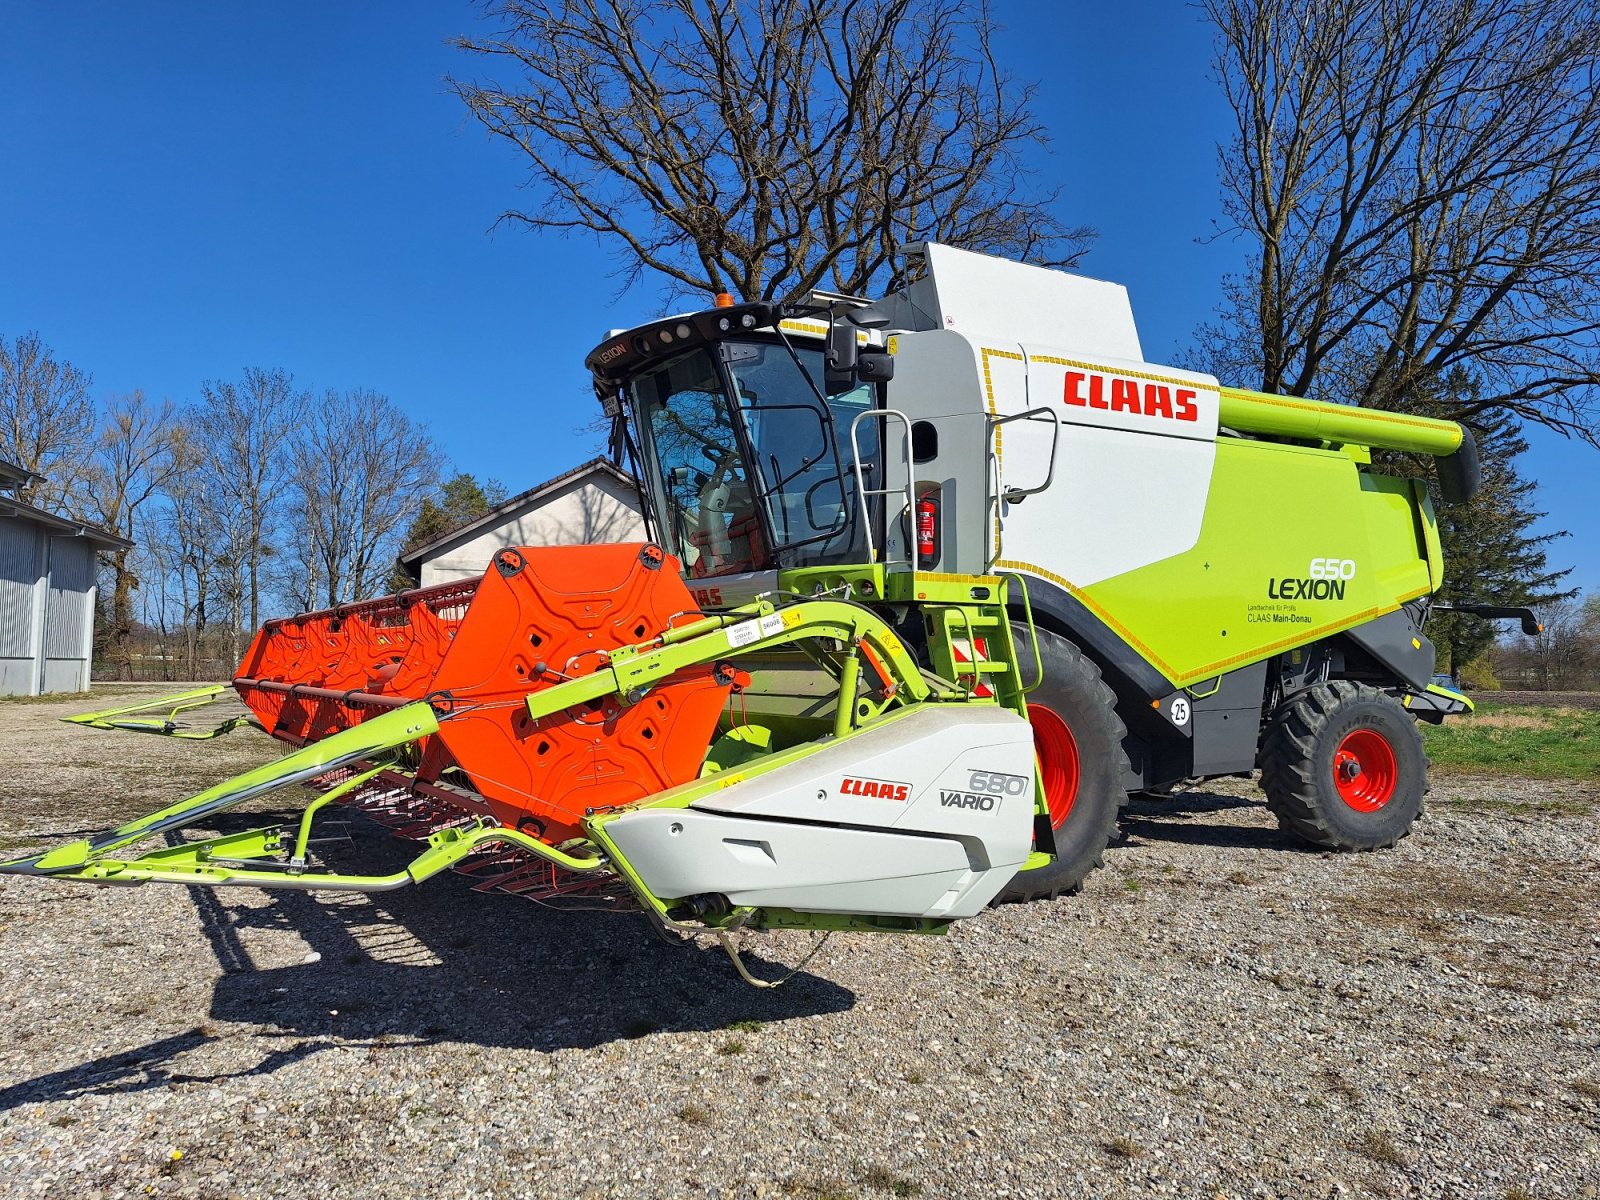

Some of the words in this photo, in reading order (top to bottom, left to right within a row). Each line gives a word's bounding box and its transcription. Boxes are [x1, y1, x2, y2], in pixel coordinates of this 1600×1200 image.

[599, 343, 627, 363] LEXION
[1063, 371, 1198, 422] CLAAS
[1309, 557, 1356, 581] 650
[1268, 578, 1346, 600] LEXION
[1247, 613, 1271, 623] CLAAS
[1273, 613, 1312, 623] Main-Donau
[1175, 703, 1186, 721] 25
[839, 778, 909, 802] CLAAS
[969, 772, 1025, 796] 680
[939, 791, 995, 812] VARIO
